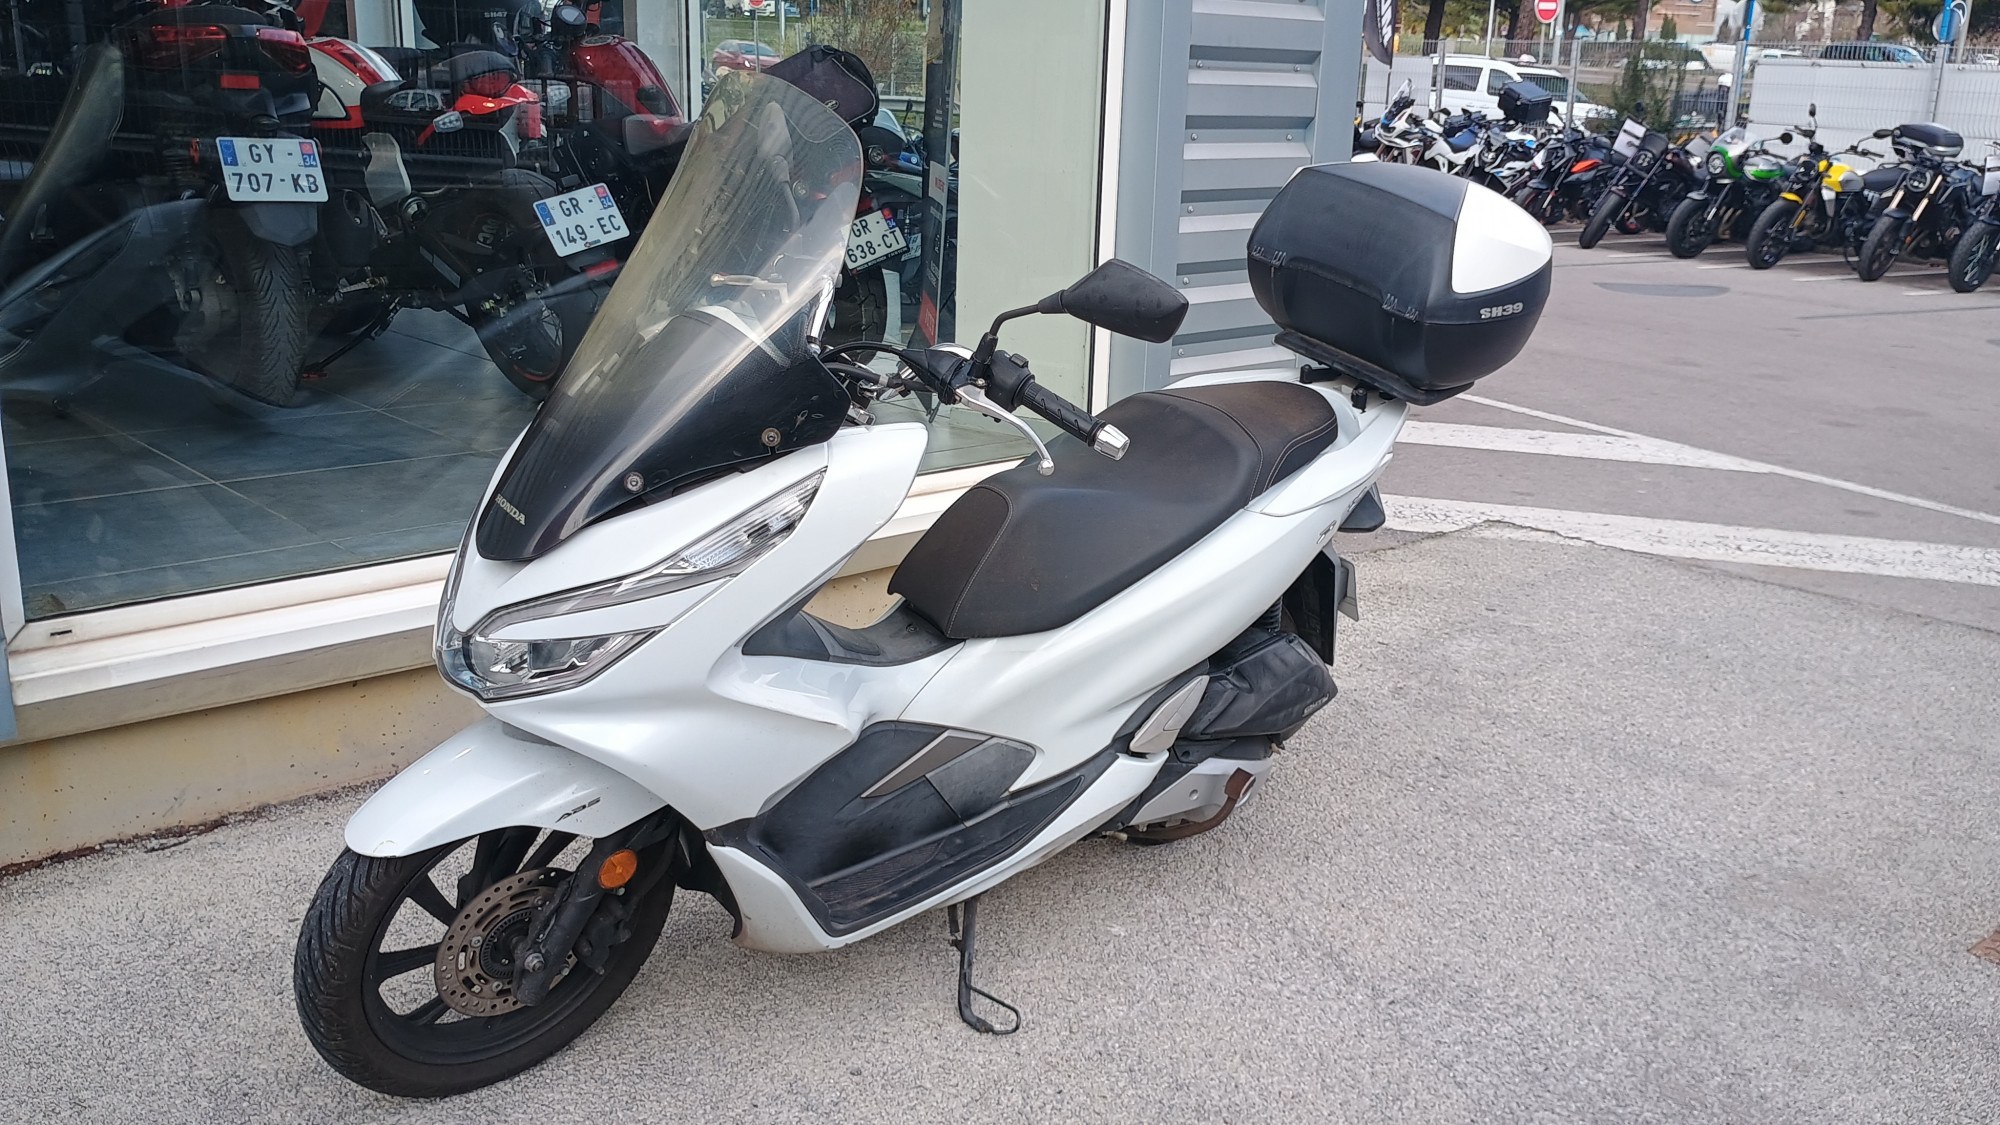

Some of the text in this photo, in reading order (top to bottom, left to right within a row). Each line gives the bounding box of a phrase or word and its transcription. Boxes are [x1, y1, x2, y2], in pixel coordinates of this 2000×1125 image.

[248, 144, 274, 164] GY
[303, 154, 317, 167] 34
[558, 197, 584, 218] GR
[601, 196, 613, 208] 34
[851, 218, 872, 238] GR
[886, 218, 897, 229] 34
[1479, 302, 1524, 319] SH39
[495, 494, 526, 526] HONDA
